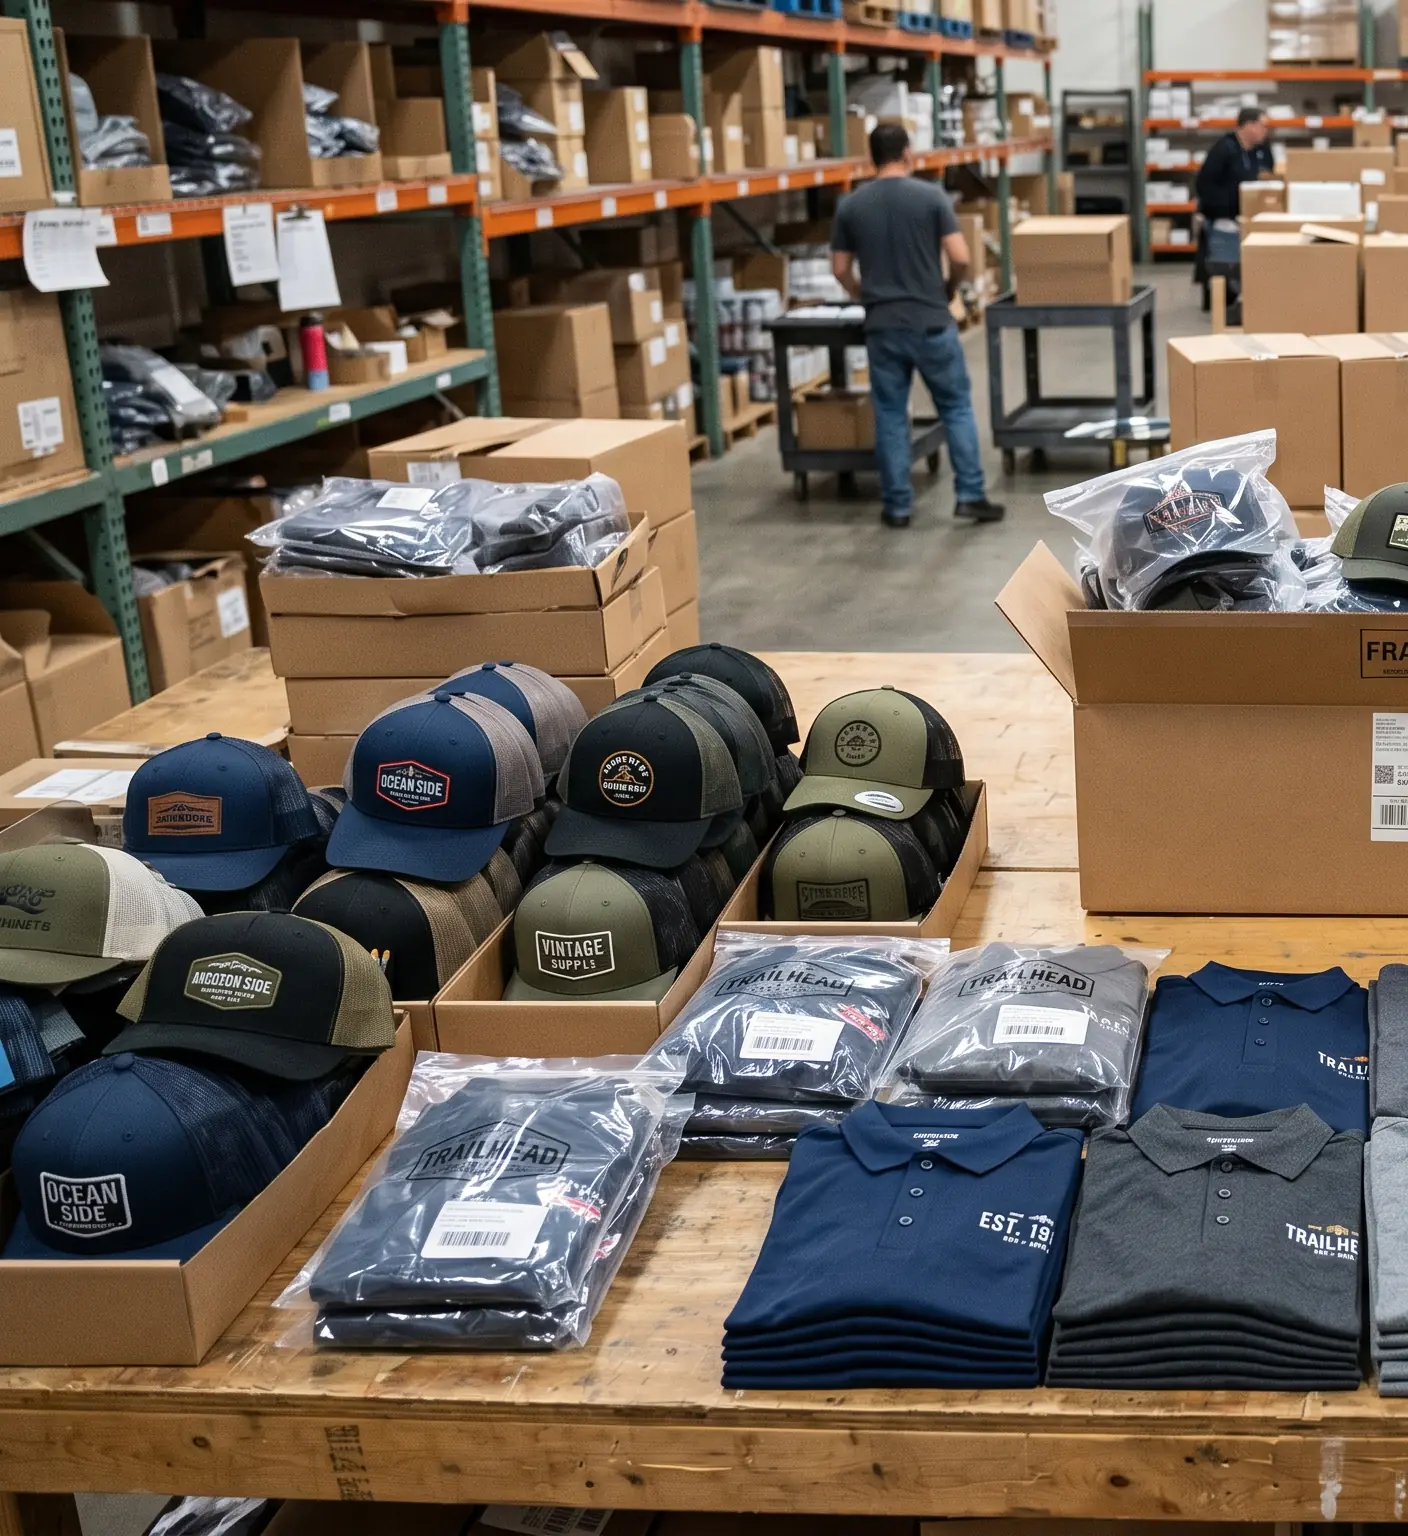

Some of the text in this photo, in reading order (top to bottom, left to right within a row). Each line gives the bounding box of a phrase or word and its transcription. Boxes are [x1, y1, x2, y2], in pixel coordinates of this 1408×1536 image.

[381, 774, 415, 792] OCEAN
[416, 780, 443, 797] SIDE
[542, 938, 604, 957] VINTAGE
[243, 977, 272, 994] SIDE
[1318, 1051, 1368, 1075] TRAIL
[47, 1181, 118, 1205] OCEAN
[61, 1205, 107, 1222] SIDE
[979, 1211, 1021, 1236] EST.
[1030, 1224, 1055, 1246] 19
[1286, 1222, 1358, 1255] TRAILHE
